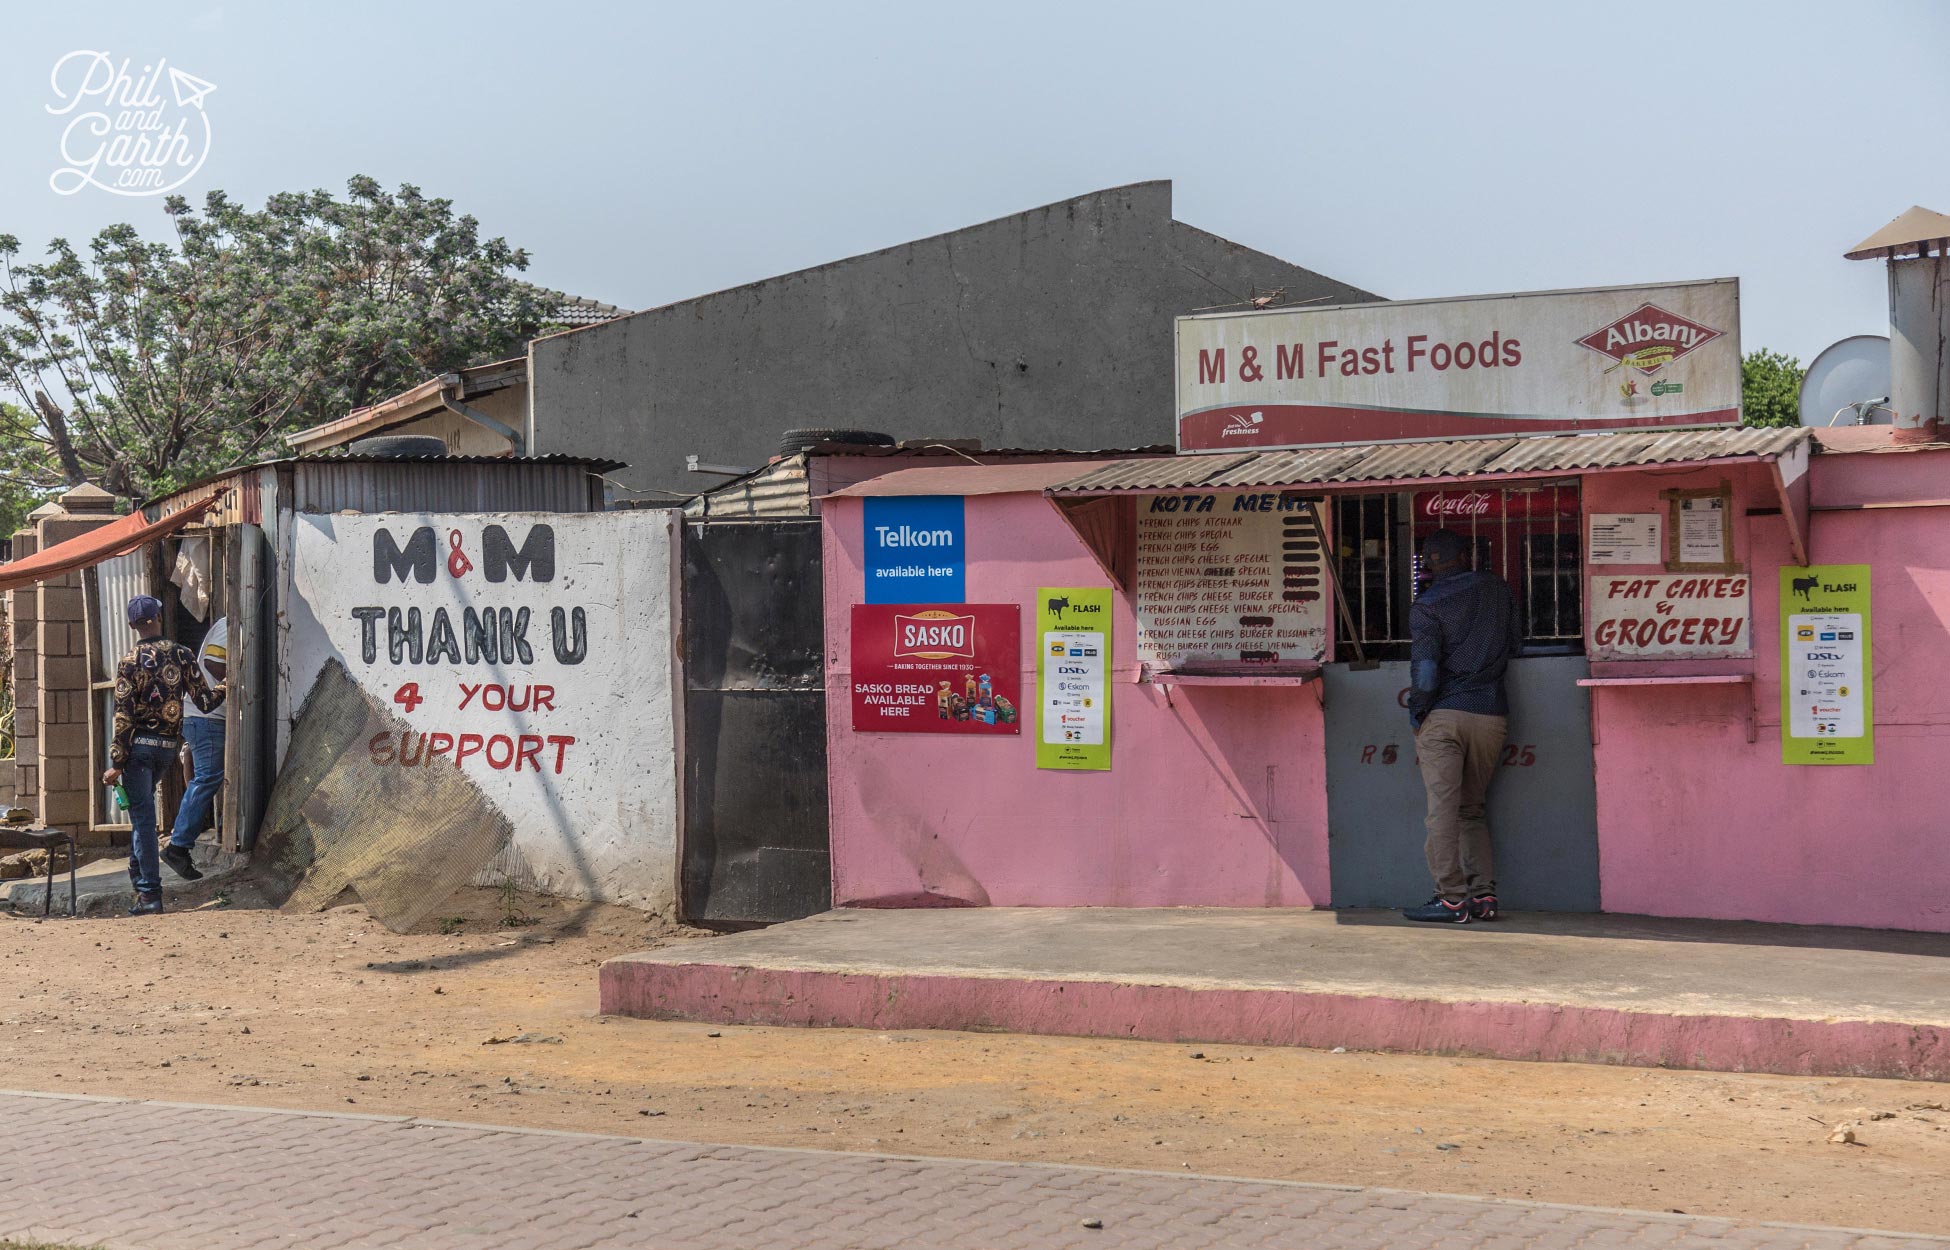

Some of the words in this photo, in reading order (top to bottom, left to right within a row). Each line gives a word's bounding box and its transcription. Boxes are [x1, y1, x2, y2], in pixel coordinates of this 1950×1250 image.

[1606, 320, 1708, 351] Albany
[1199, 349, 1225, 385] M
[1238, 346, 1264, 382] &
[1275, 342, 1305, 380] M
[1318, 338, 1395, 378] Fast
[1406, 331, 1522, 372] Foods
[1221, 428, 1260, 438] freshness
[1149, 495, 1217, 513] KOTA
[1144, 519, 1172, 528] FRENCH
[1176, 518, 1200, 527] CHIPS
[1204, 517, 1243, 527] ATCHAAR
[875, 526, 953, 548] Telkom
[1143, 531, 1172, 541] FRENCH
[1174, 531, 1197, 540] CHIPS
[1199, 530, 1234, 539] SPECIAL
[1143, 544, 1171, 553] FRENCH
[1174, 543, 1197, 552] CHIPS
[1200, 543, 1220, 552] EGG
[1142, 556, 1170, 565] FRENCH
[1171, 555, 1195, 564] CHIPS
[1197, 555, 1231, 564] CHEESE
[1233, 553, 1271, 563] SPECIAL
[876, 565, 926, 578] available
[927, 566, 953, 577] here
[1142, 568, 1170, 577] FRENCH
[1171, 567, 1201, 577] VIENNA
[1238, 566, 1272, 576] SPECIAL
[1142, 580, 1171, 589] FRENCH
[1173, 579, 1196, 589] CHIPS
[1197, 579, 1228, 588] CHEESE
[1608, 579, 1660, 599] FAT
[1665, 578, 1748, 599] CAKES
[1823, 584, 1857, 593] FLASH
[1144, 592, 1174, 601] FRENCH
[1176, 592, 1198, 601] CHIPS
[1201, 592, 1233, 601] CHEESE
[1239, 591, 1274, 601] BURGER
[1073, 604, 1101, 613] FLASH
[1143, 605, 1173, 614] FRENCH
[1174, 605, 1196, 614] CHIPS
[1198, 604, 1229, 614] CHEESE
[1233, 604, 1264, 613] VIENNA
[1267, 603, 1302, 613] SPECIAL
[1655, 600, 1675, 616] &
[1800, 606, 1833, 614] Available
[1154, 617, 1191, 626] RUSSIAN
[1196, 617, 1217, 626] EGG
[351, 605, 534, 666] THANK
[550, 605, 588, 666] U
[904, 624, 965, 648] SASKO
[1144, 629, 1174, 639] FRENCH
[1176, 629, 1207, 639] CHEESE
[1210, 629, 1235, 639] CHIPS
[1240, 629, 1274, 639] BURGER
[1277, 629, 1308, 638] RUSSIAN
[1594, 617, 1744, 648] GROCERY
[1143, 642, 1174, 651] FRENCH
[1177, 642, 1209, 650] BURGER
[1211, 642, 1233, 650] CHIPS
[1235, 641, 1263, 650] CHEESE
[1156, 652, 1181, 660] RUSSI
[1807, 652, 1845, 661] DStv
[1058, 666, 1090, 675] DStv
[1818, 670, 1846, 678] Eskom
[855, 684, 893, 694] SASKO
[895, 684, 934, 694] BREAD
[1067, 682, 1090, 691] Eskom
[393, 682, 424, 713] 4
[458, 682, 555, 715] YOUR
[864, 695, 926, 705] AVAILABLE
[880, 706, 910, 717] HERE
[368, 731, 576, 775] SUPPORT
